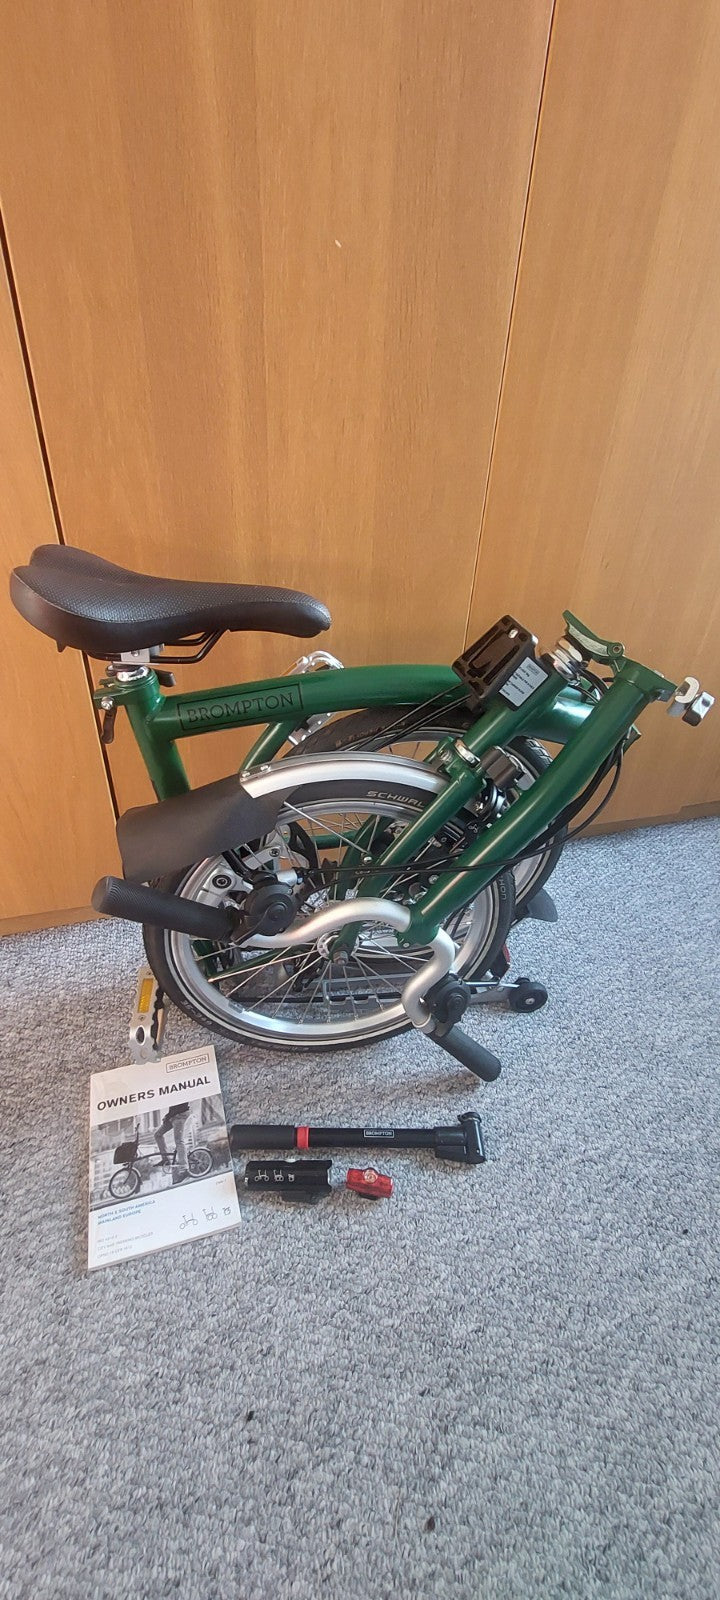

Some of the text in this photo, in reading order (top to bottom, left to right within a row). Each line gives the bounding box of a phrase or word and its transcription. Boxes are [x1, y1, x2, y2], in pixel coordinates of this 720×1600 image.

[186, 691, 294, 723] BROMPTON
[366, 790, 425, 808] SCHWAL
[168, 1056, 208, 1071] BROMPTON
[97, 1076, 211, 1111] OWNERS MANUAL
